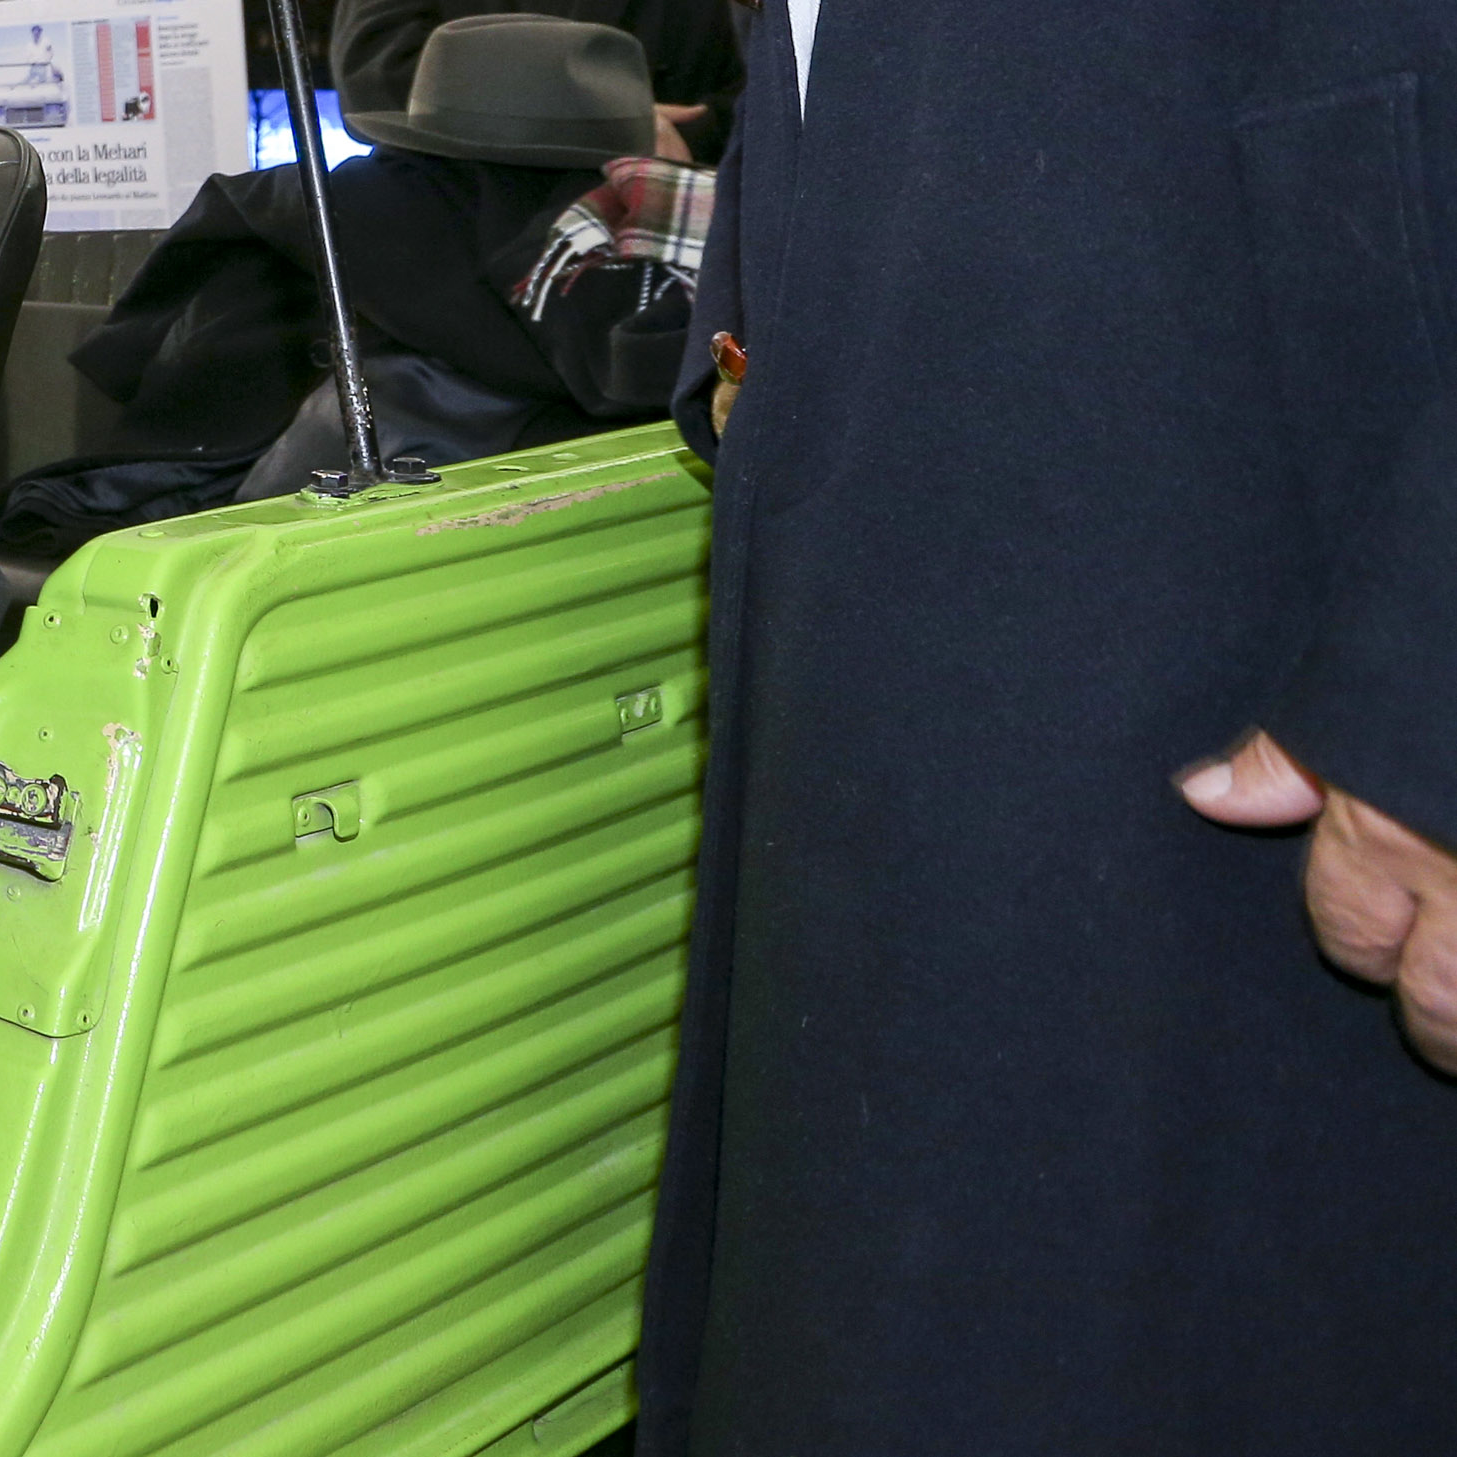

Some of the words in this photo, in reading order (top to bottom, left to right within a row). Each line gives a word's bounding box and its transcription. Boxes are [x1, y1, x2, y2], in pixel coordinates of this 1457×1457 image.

[48, 148, 74, 162] con
[77, 144, 90, 161] la
[94, 142, 147, 160] Mehari
[57, 166, 90, 184] della
[94, 163, 147, 188] legalità
